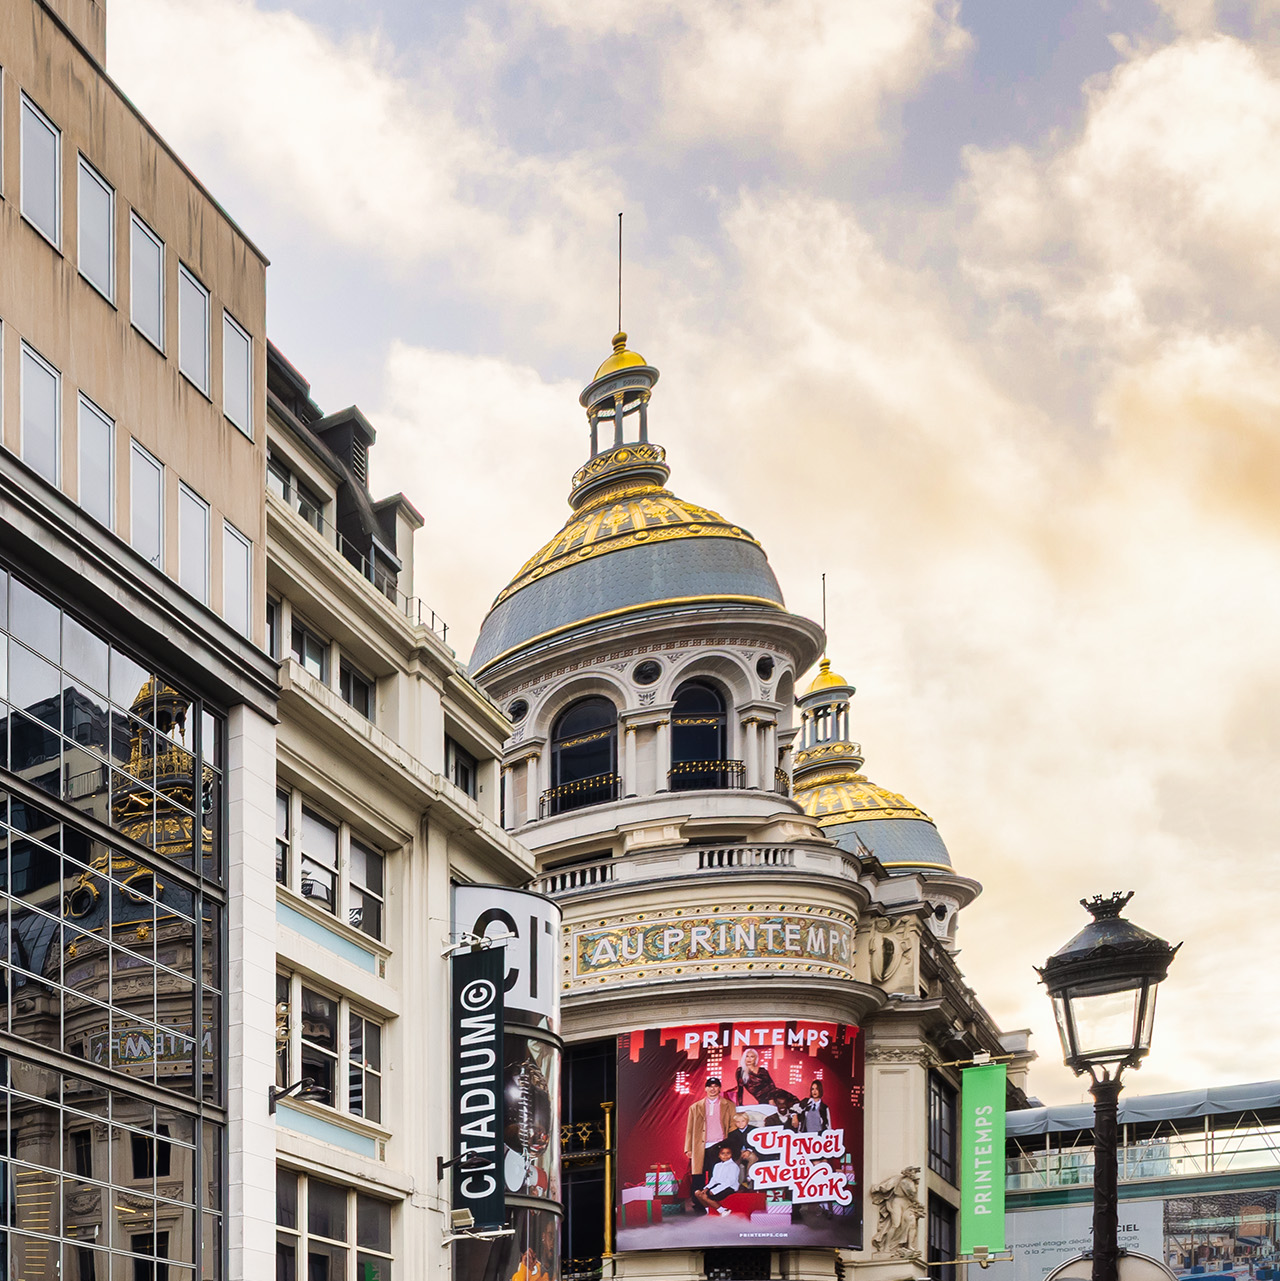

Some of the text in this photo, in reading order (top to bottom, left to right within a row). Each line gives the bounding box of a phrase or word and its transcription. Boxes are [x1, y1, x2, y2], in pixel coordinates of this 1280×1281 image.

[590, 923, 849, 966] AU PRINTEMPS
[684, 1028, 830, 1050] PRINTEMPS
[753, 1131, 840, 1167] Un Noël
[974, 1105, 993, 1215] PRINTEMPS
[798, 1156, 806, 1165] à
[754, 1165, 810, 1184] New
[1015, 1241, 1041, 1249] nouvel
[1043, 1238, 1067, 1247] étage
